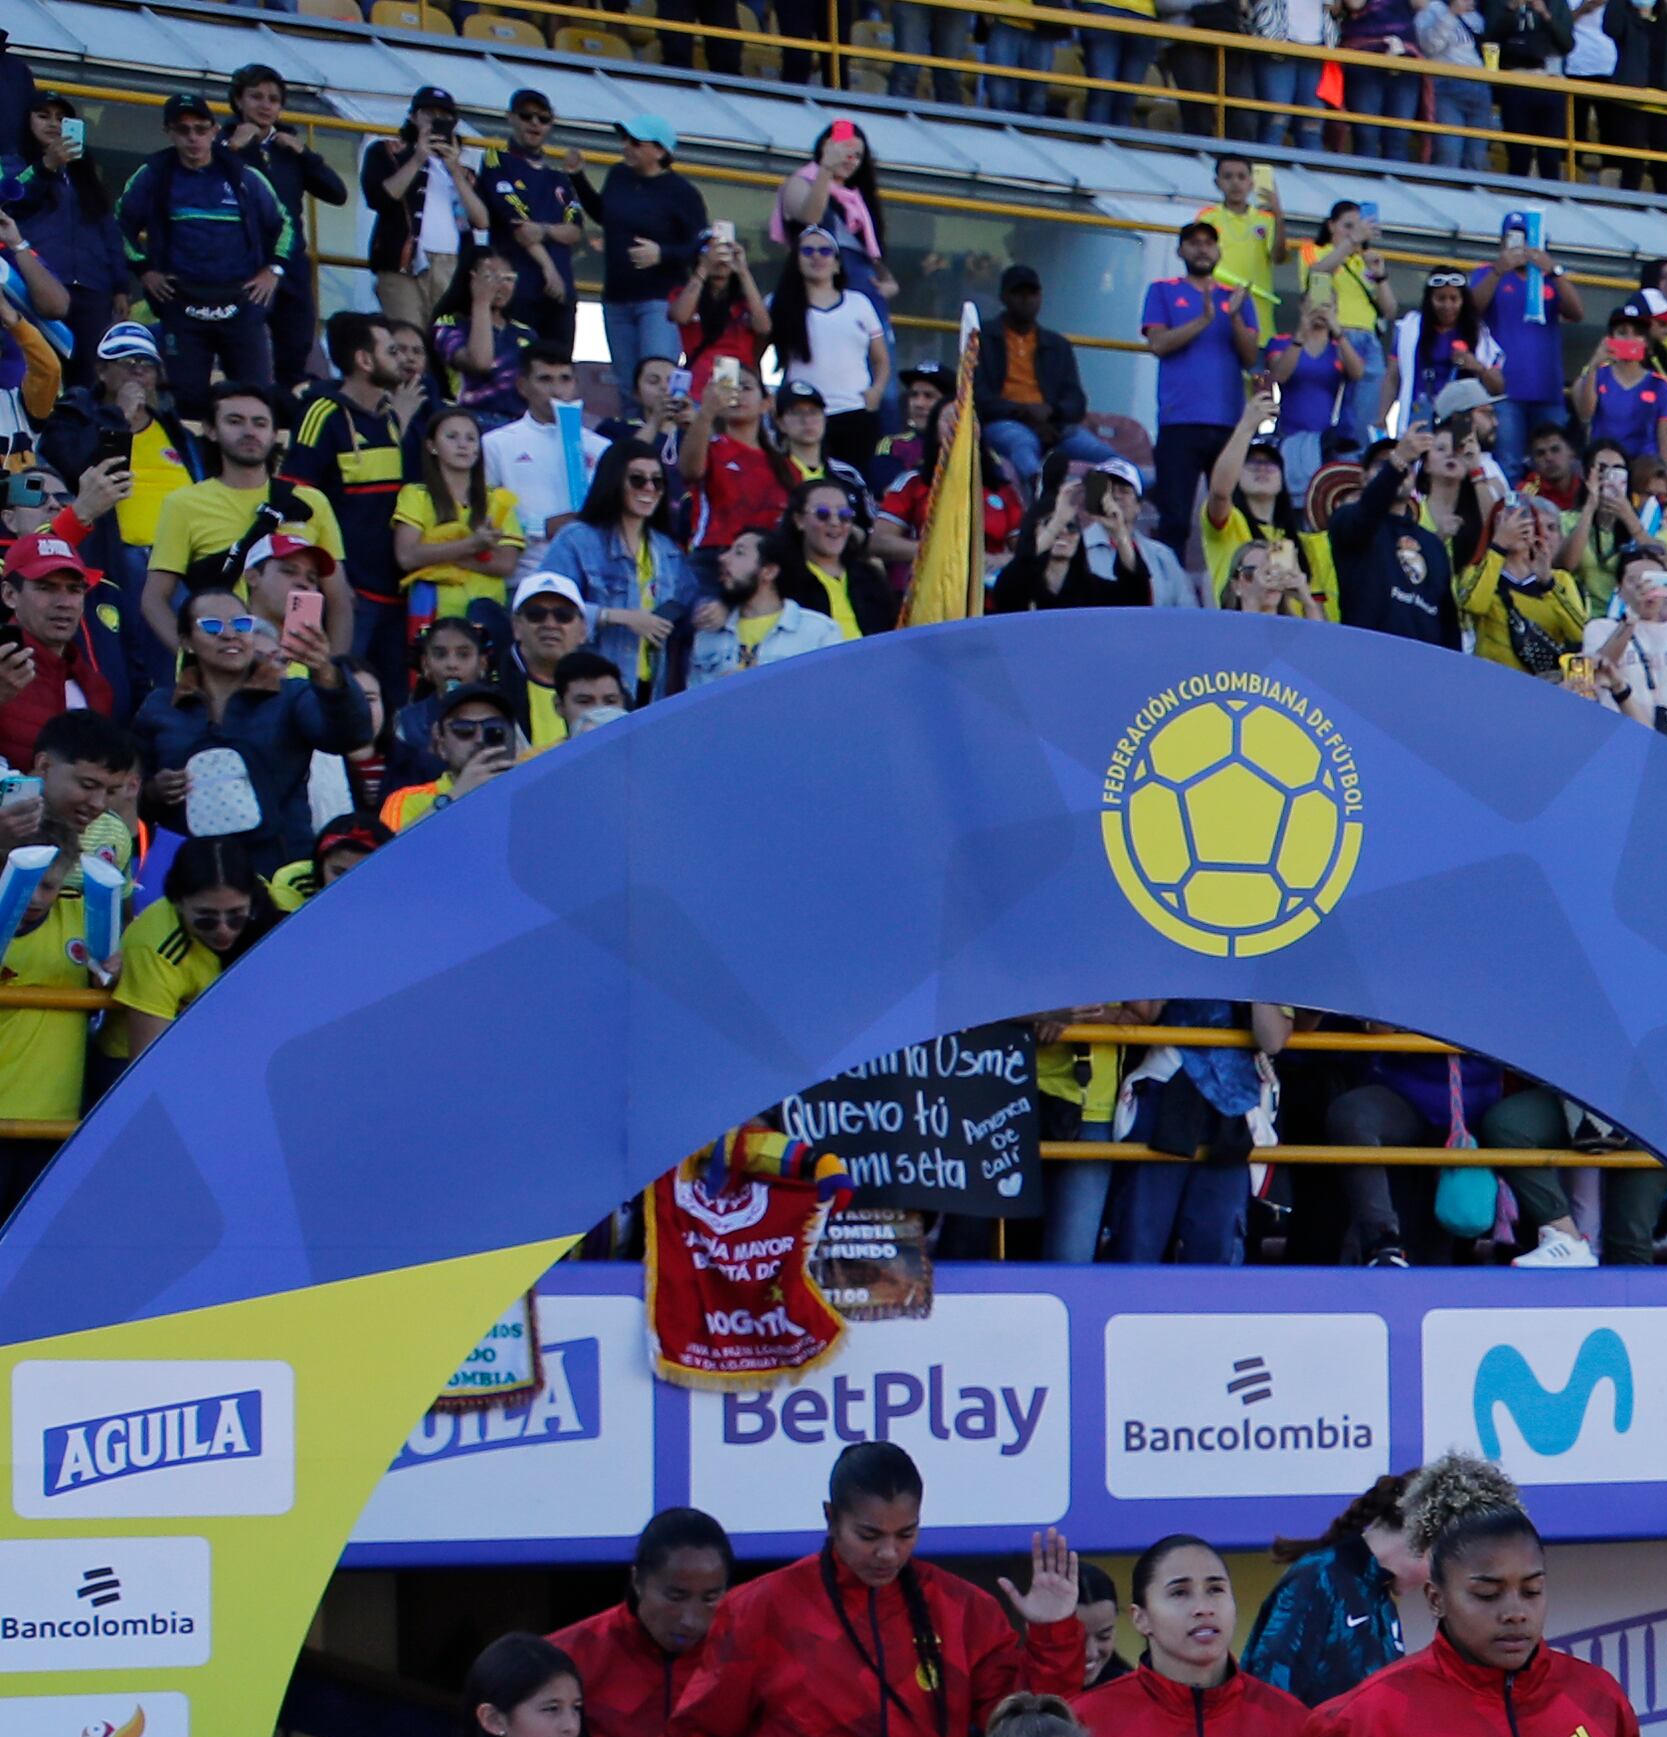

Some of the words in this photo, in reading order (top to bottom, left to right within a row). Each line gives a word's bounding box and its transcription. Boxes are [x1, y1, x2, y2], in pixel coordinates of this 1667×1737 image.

[1102, 688, 1181, 806] FEDERACIÓN
[1178, 671, 1310, 717] COLOMBIANA
[1306, 707, 1333, 737] DE
[1324, 733, 1364, 817] FÚTBOL
[734, 1235, 795, 1262] MAYOR
[723, 1363, 1049, 1456] BetPlay
[1122, 1415, 1374, 1452] Bancolombia
[54, 1398, 251, 1490] AGUILA
[0, 1612, 195, 1642] Bancolombia
